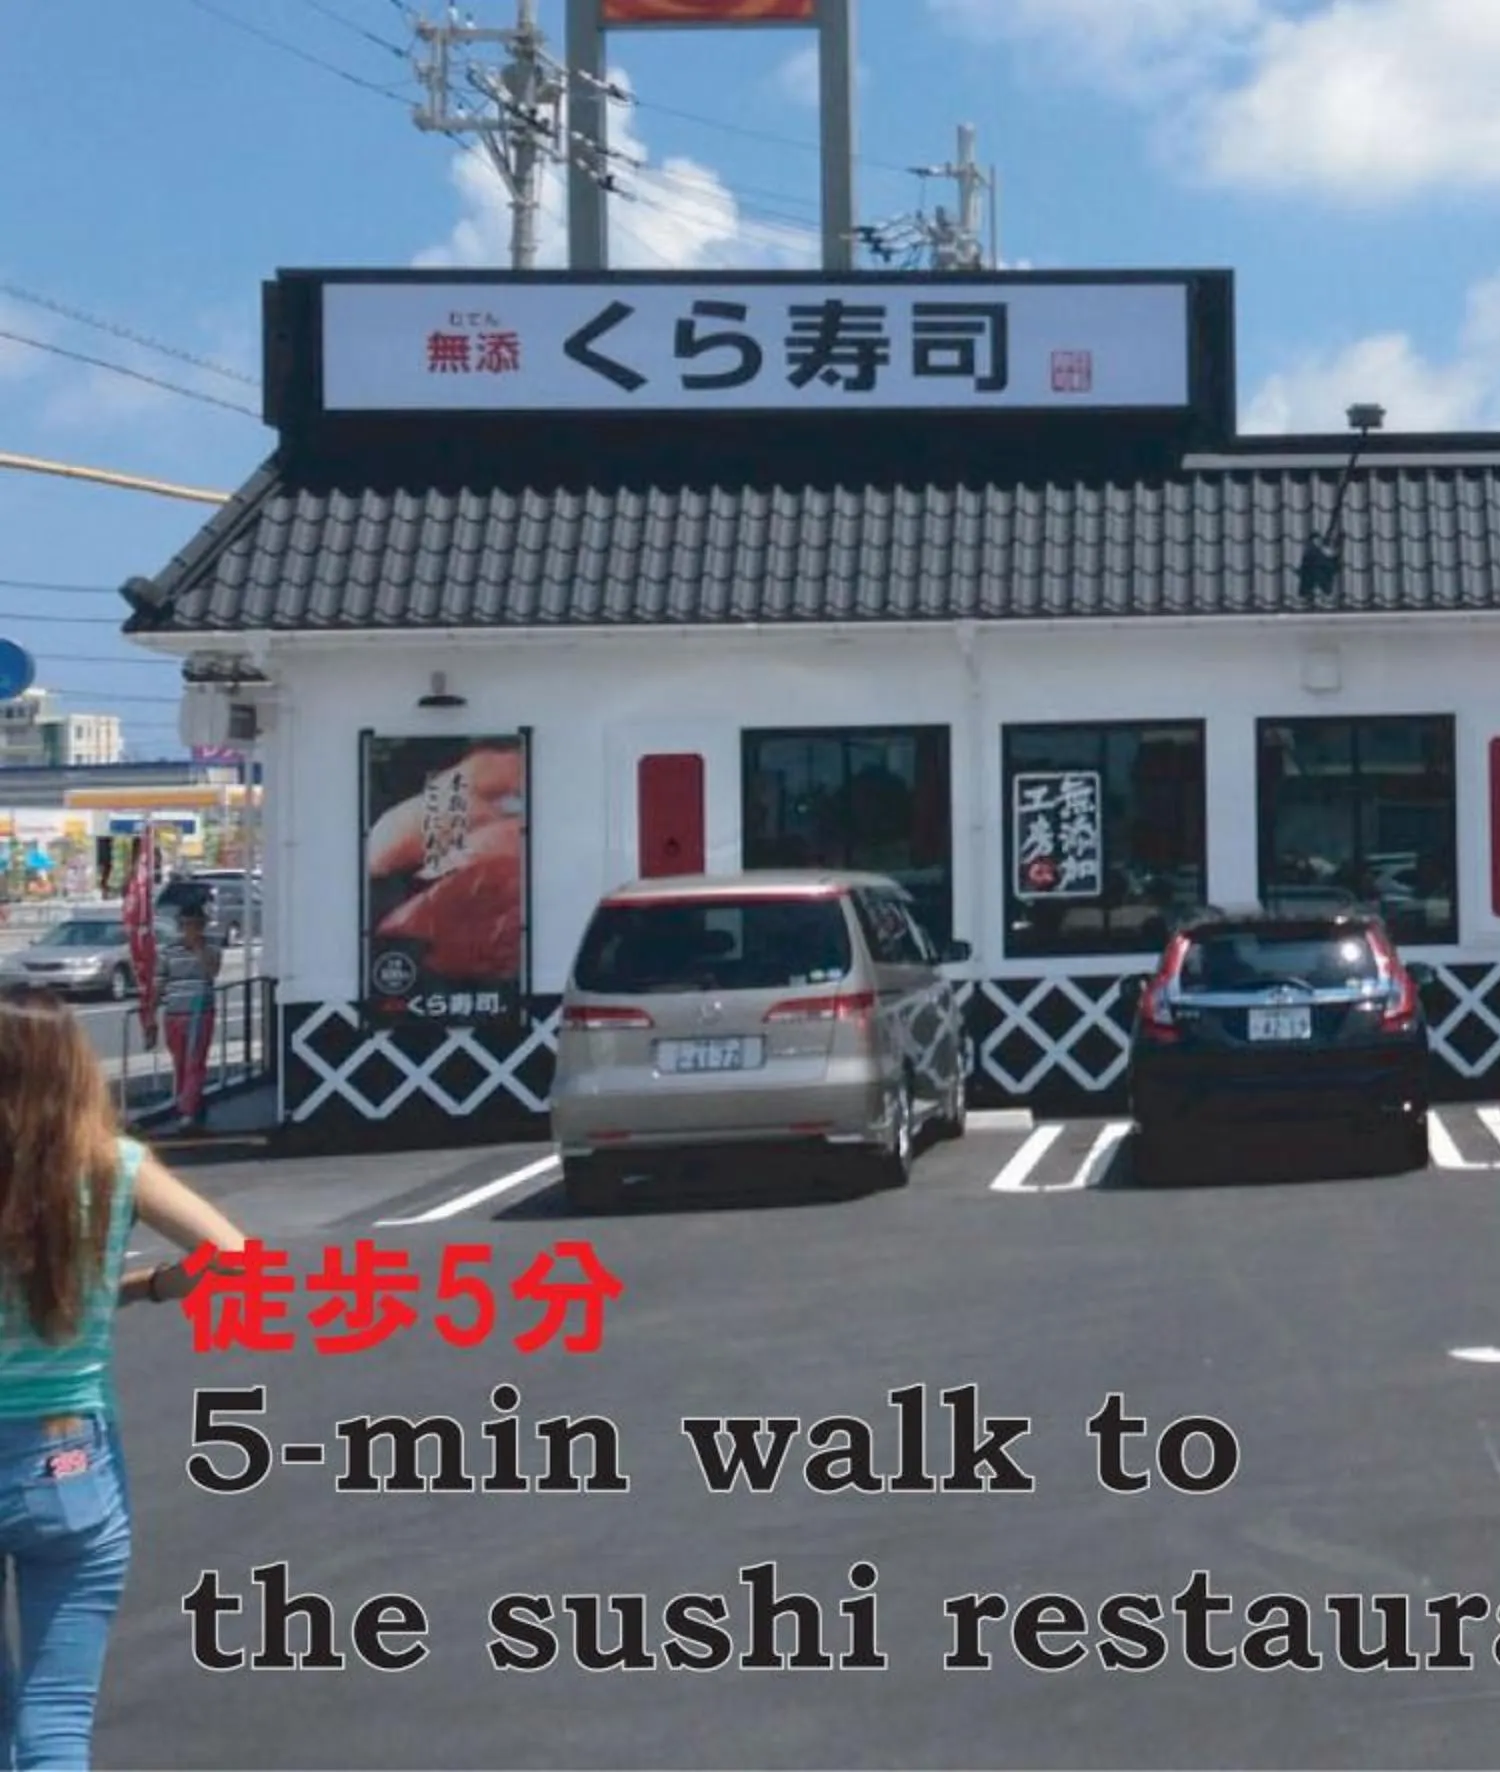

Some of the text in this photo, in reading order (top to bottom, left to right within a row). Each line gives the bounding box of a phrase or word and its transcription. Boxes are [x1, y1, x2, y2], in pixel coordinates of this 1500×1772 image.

[427, 331, 520, 373] 無添
[562, 299, 1009, 393] くら寿司
[449, 311, 499, 327] むてん
